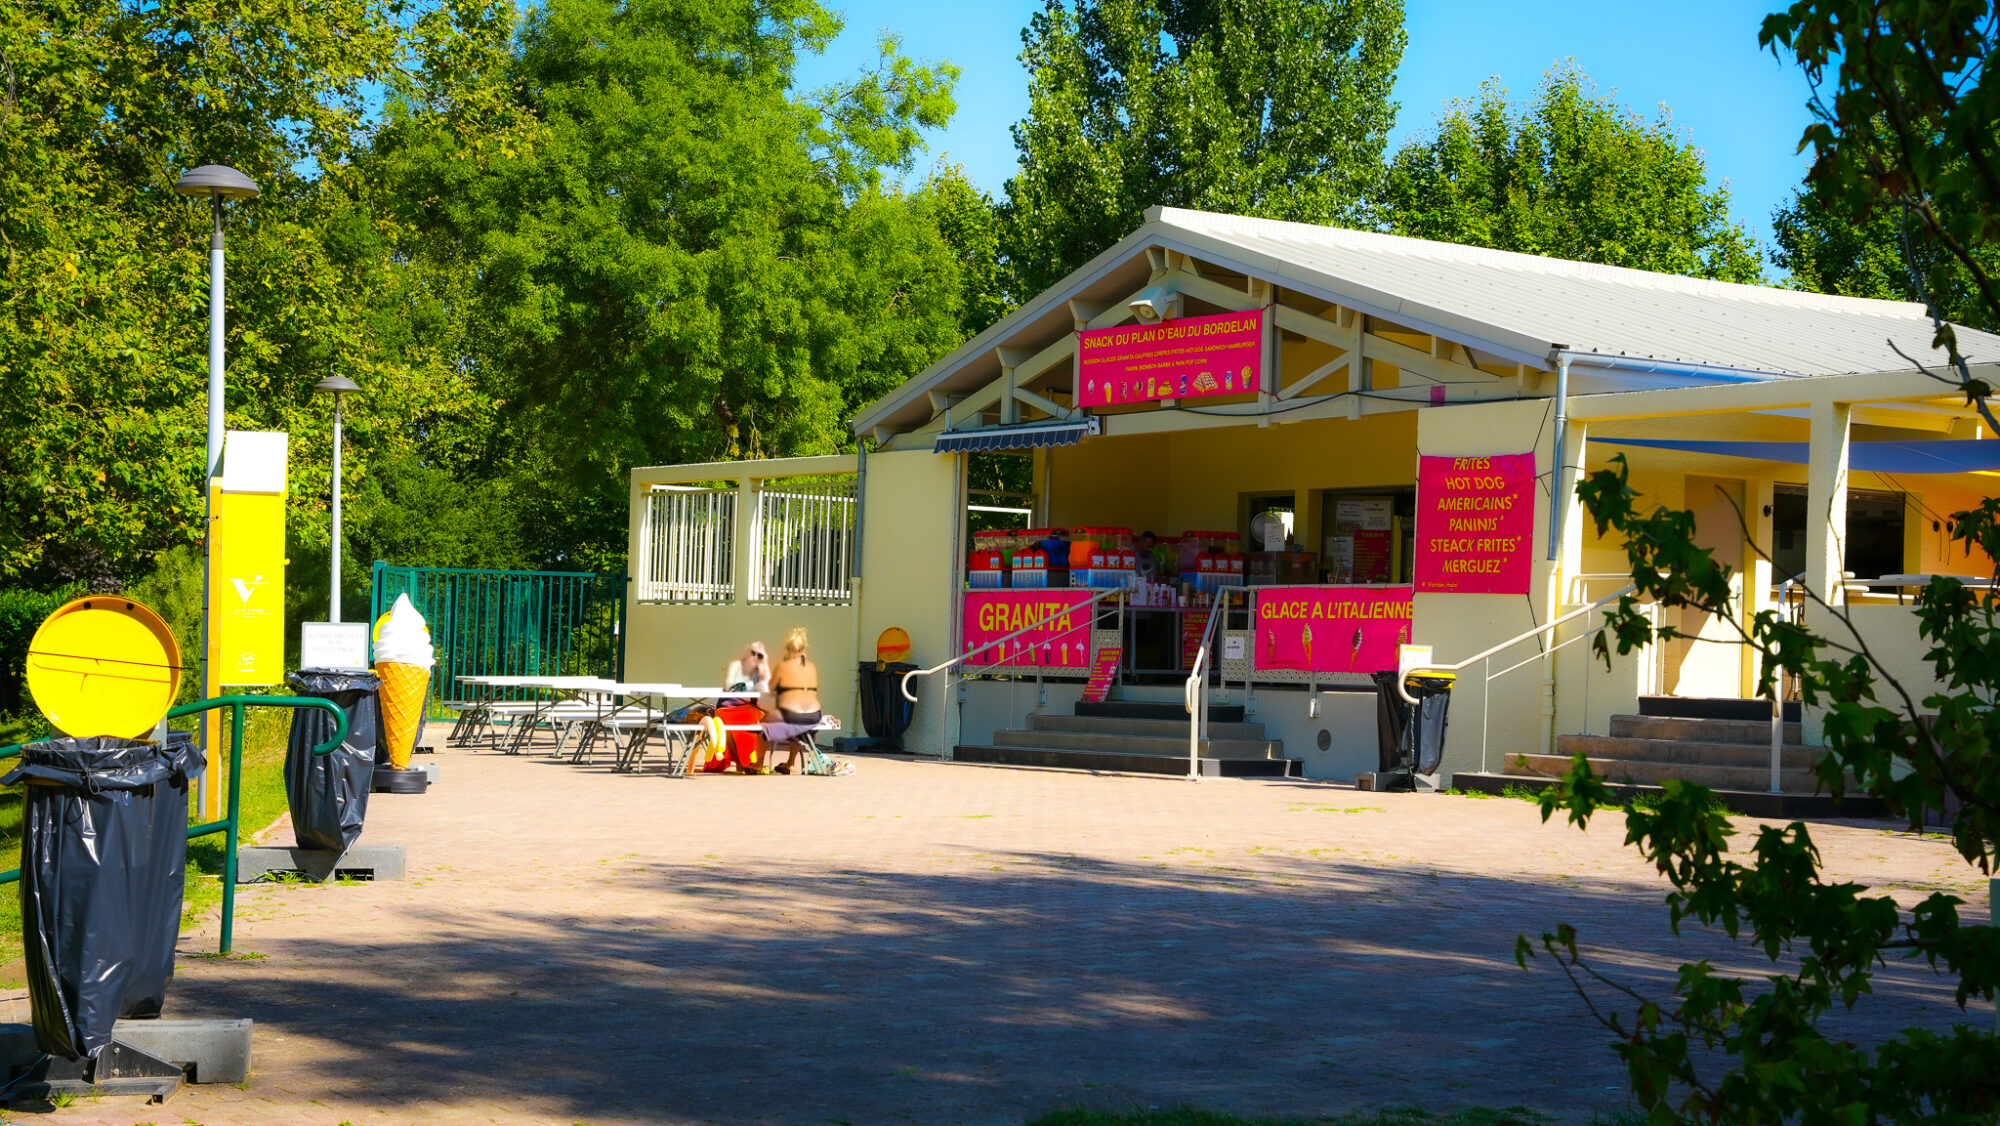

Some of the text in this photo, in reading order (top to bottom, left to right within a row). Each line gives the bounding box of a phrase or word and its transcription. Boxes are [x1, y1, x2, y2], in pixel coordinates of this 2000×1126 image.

[1084, 318, 1256, 349] SNACK DU PLAN D'EAU DU BORDELAN
[1453, 457, 1490, 470] FRITES
[1445, 476, 1505, 490] HOT DOG
[1430, 539, 1474, 552] STEACK
[979, 602, 1072, 632] GRANITA
[1262, 601, 1413, 619] GLACE A L'ITALIENNE
